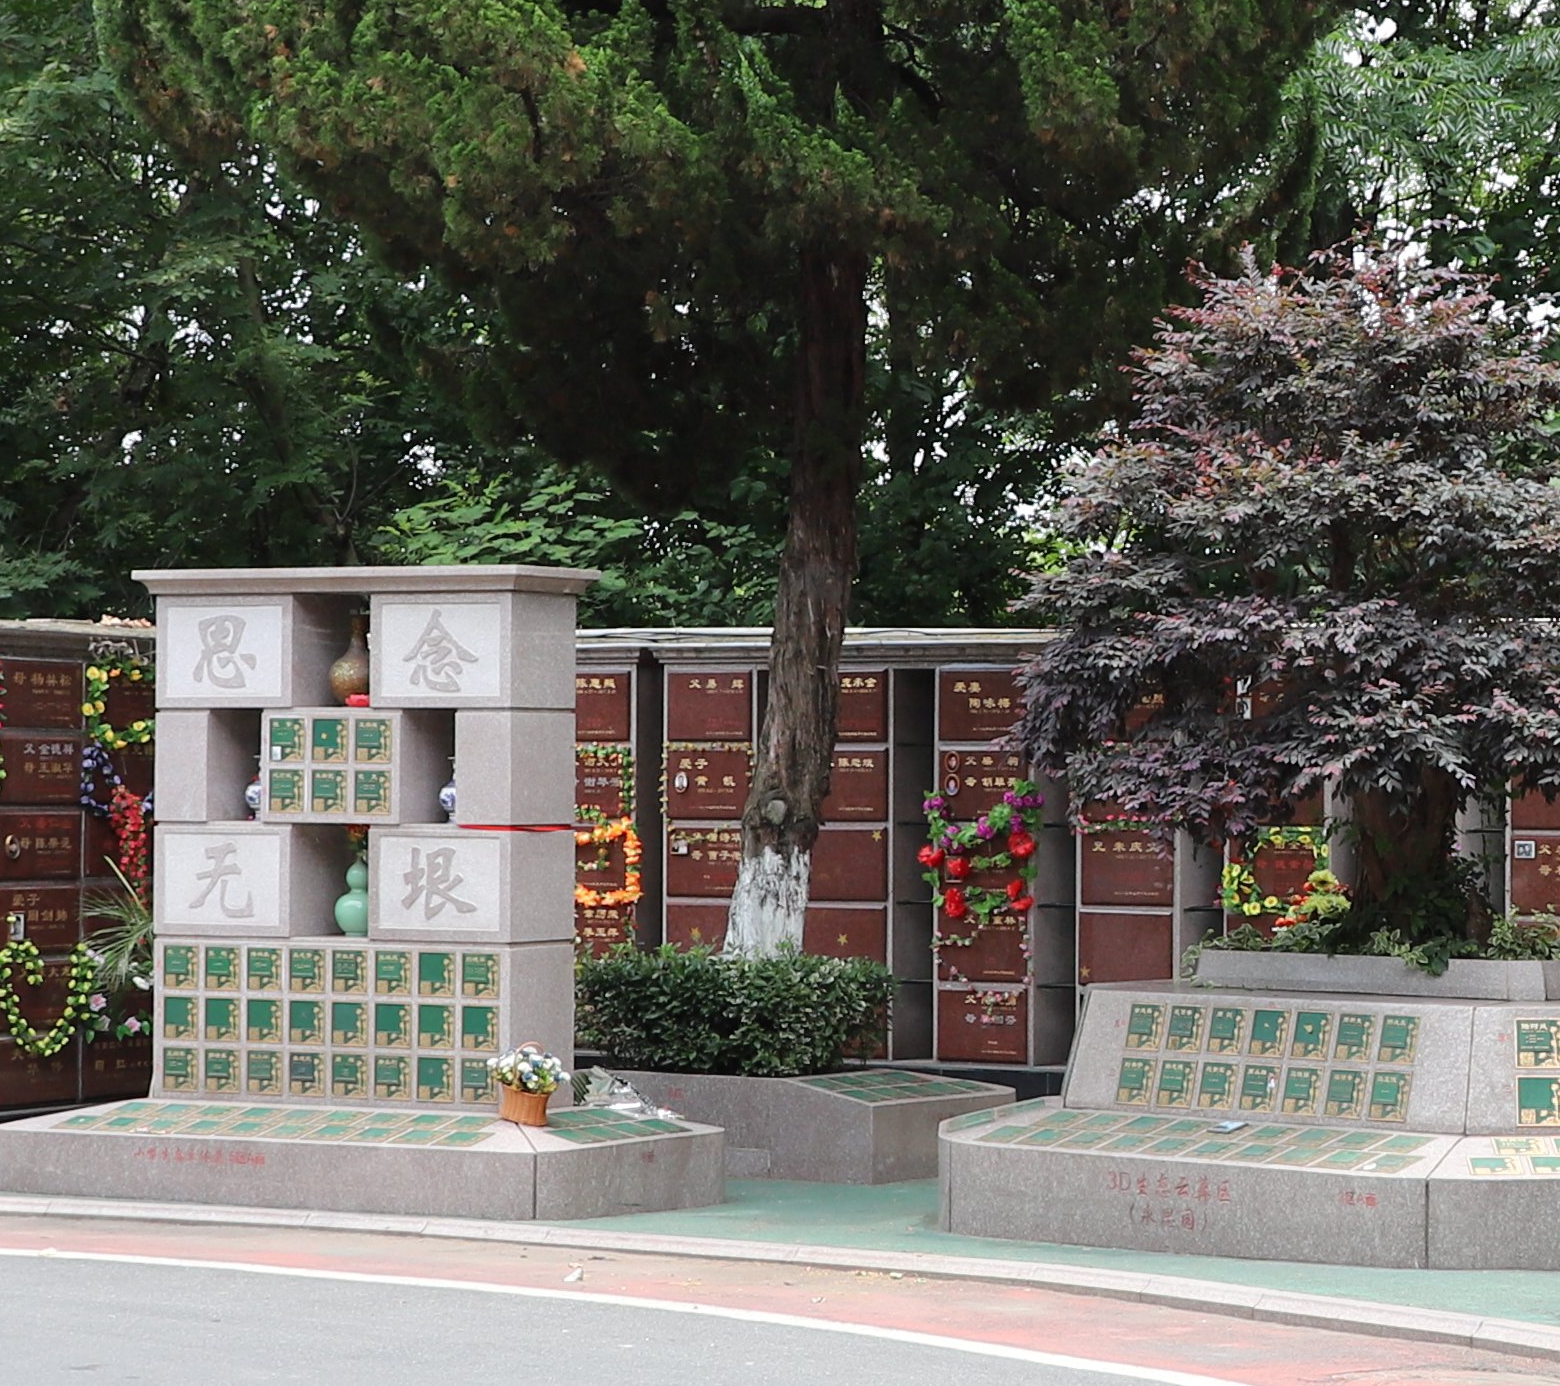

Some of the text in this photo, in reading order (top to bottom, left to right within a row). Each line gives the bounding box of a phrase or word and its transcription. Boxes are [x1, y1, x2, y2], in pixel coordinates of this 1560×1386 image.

[193, 609, 479, 692] 思 念
[190, 843, 477, 920] 无 垠
